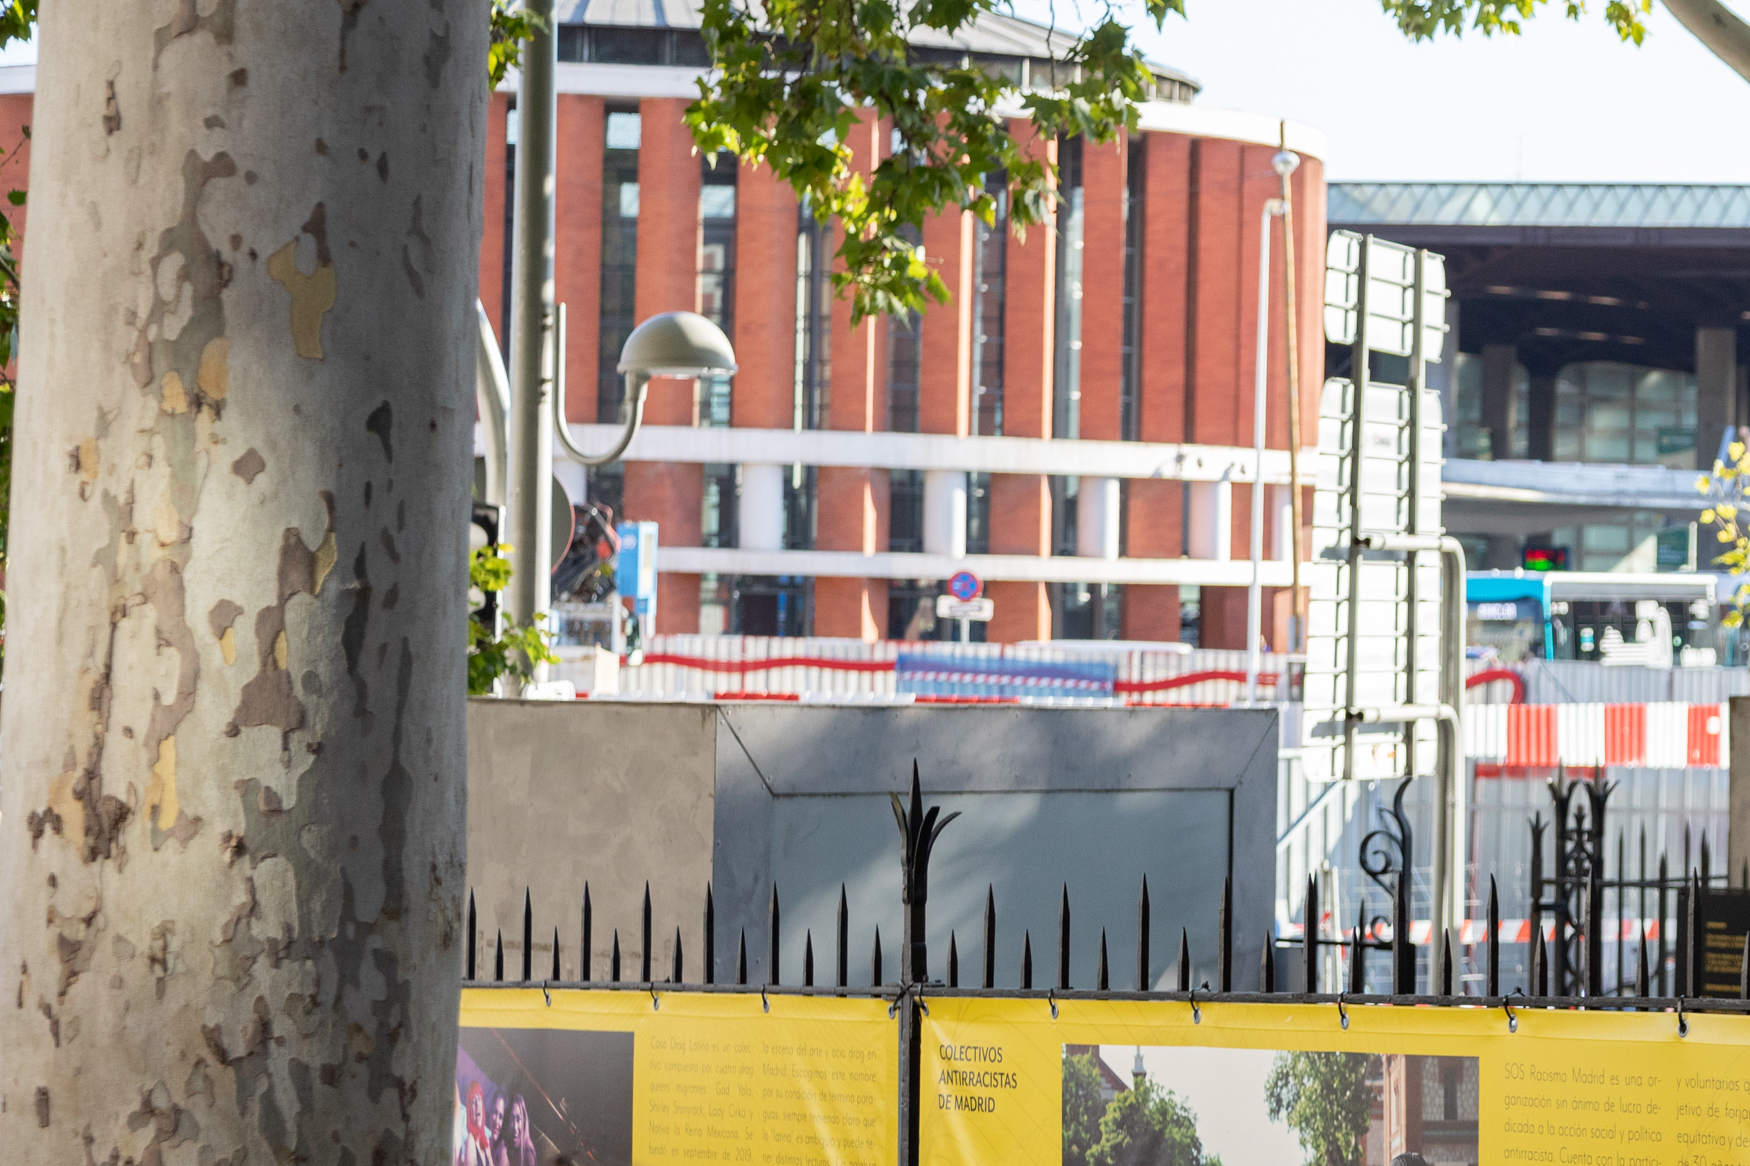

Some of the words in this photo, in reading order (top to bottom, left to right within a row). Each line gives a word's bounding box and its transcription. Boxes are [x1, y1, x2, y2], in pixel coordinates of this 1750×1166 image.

[939, 1045, 1003, 1063] COLECTIVOS
[939, 1070, 1018, 1089] ANTIRRACISTAS
[1504, 1063, 1525, 1080] SOS
[1530, 1065, 1567, 1083] Racismo
[1572, 1068, 1605, 1085] Madrid
[1610, 1074, 1619, 1085] es
[1625, 1075, 1642, 1087] una
[1648, 1076, 1661, 1088] or-
[1676, 1078, 1681, 1092] y
[1685, 1073, 1740, 1091] voluntarios
[939, 1094, 951, 1110] DE
[954, 1095, 995, 1113] MADRID
[1504, 1093, 1552, 1111] ganización
[1556, 1096, 1567, 1109] sin
[1572, 1097, 1599, 1112] ánimo
[1604, 1097, 1615, 1112] de
[1620, 1097, 1642, 1114] lucro
[1646, 1099, 1661, 1115] de-
[1676, 1101, 1702, 1120] jetivo
[1708, 1101, 1719, 1118] de
[1677, 1129, 1725, 1147] equitativa
[1728, 1136, 1733, 1150] y
